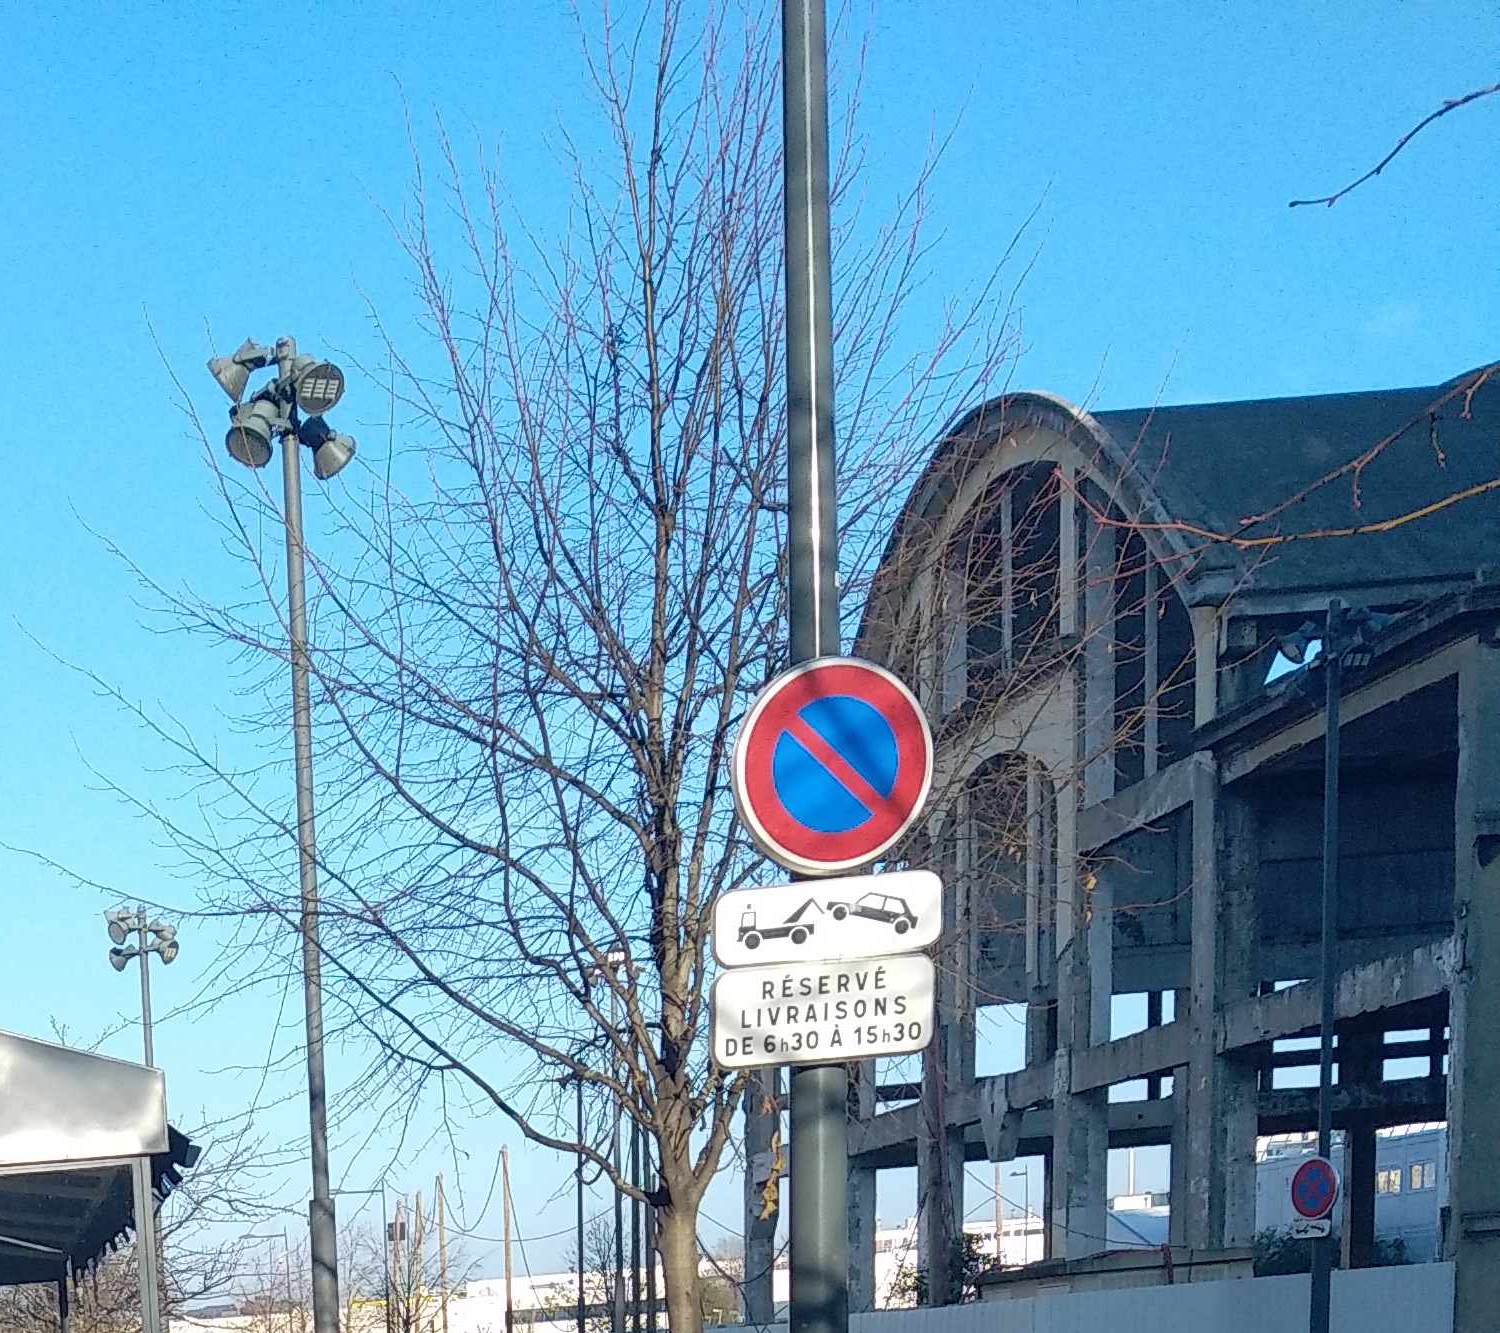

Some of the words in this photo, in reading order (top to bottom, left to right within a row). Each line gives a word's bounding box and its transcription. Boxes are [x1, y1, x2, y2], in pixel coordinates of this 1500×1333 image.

[762, 967, 886, 999] RÉSERVÉ
[741, 997, 907, 1028] LIVRAISONS
[725, 1036, 754, 1057] DE
[763, 1030, 820, 1054] 6h30
[829, 1023, 843, 1048] À
[854, 1021, 922, 1045] 15h30
